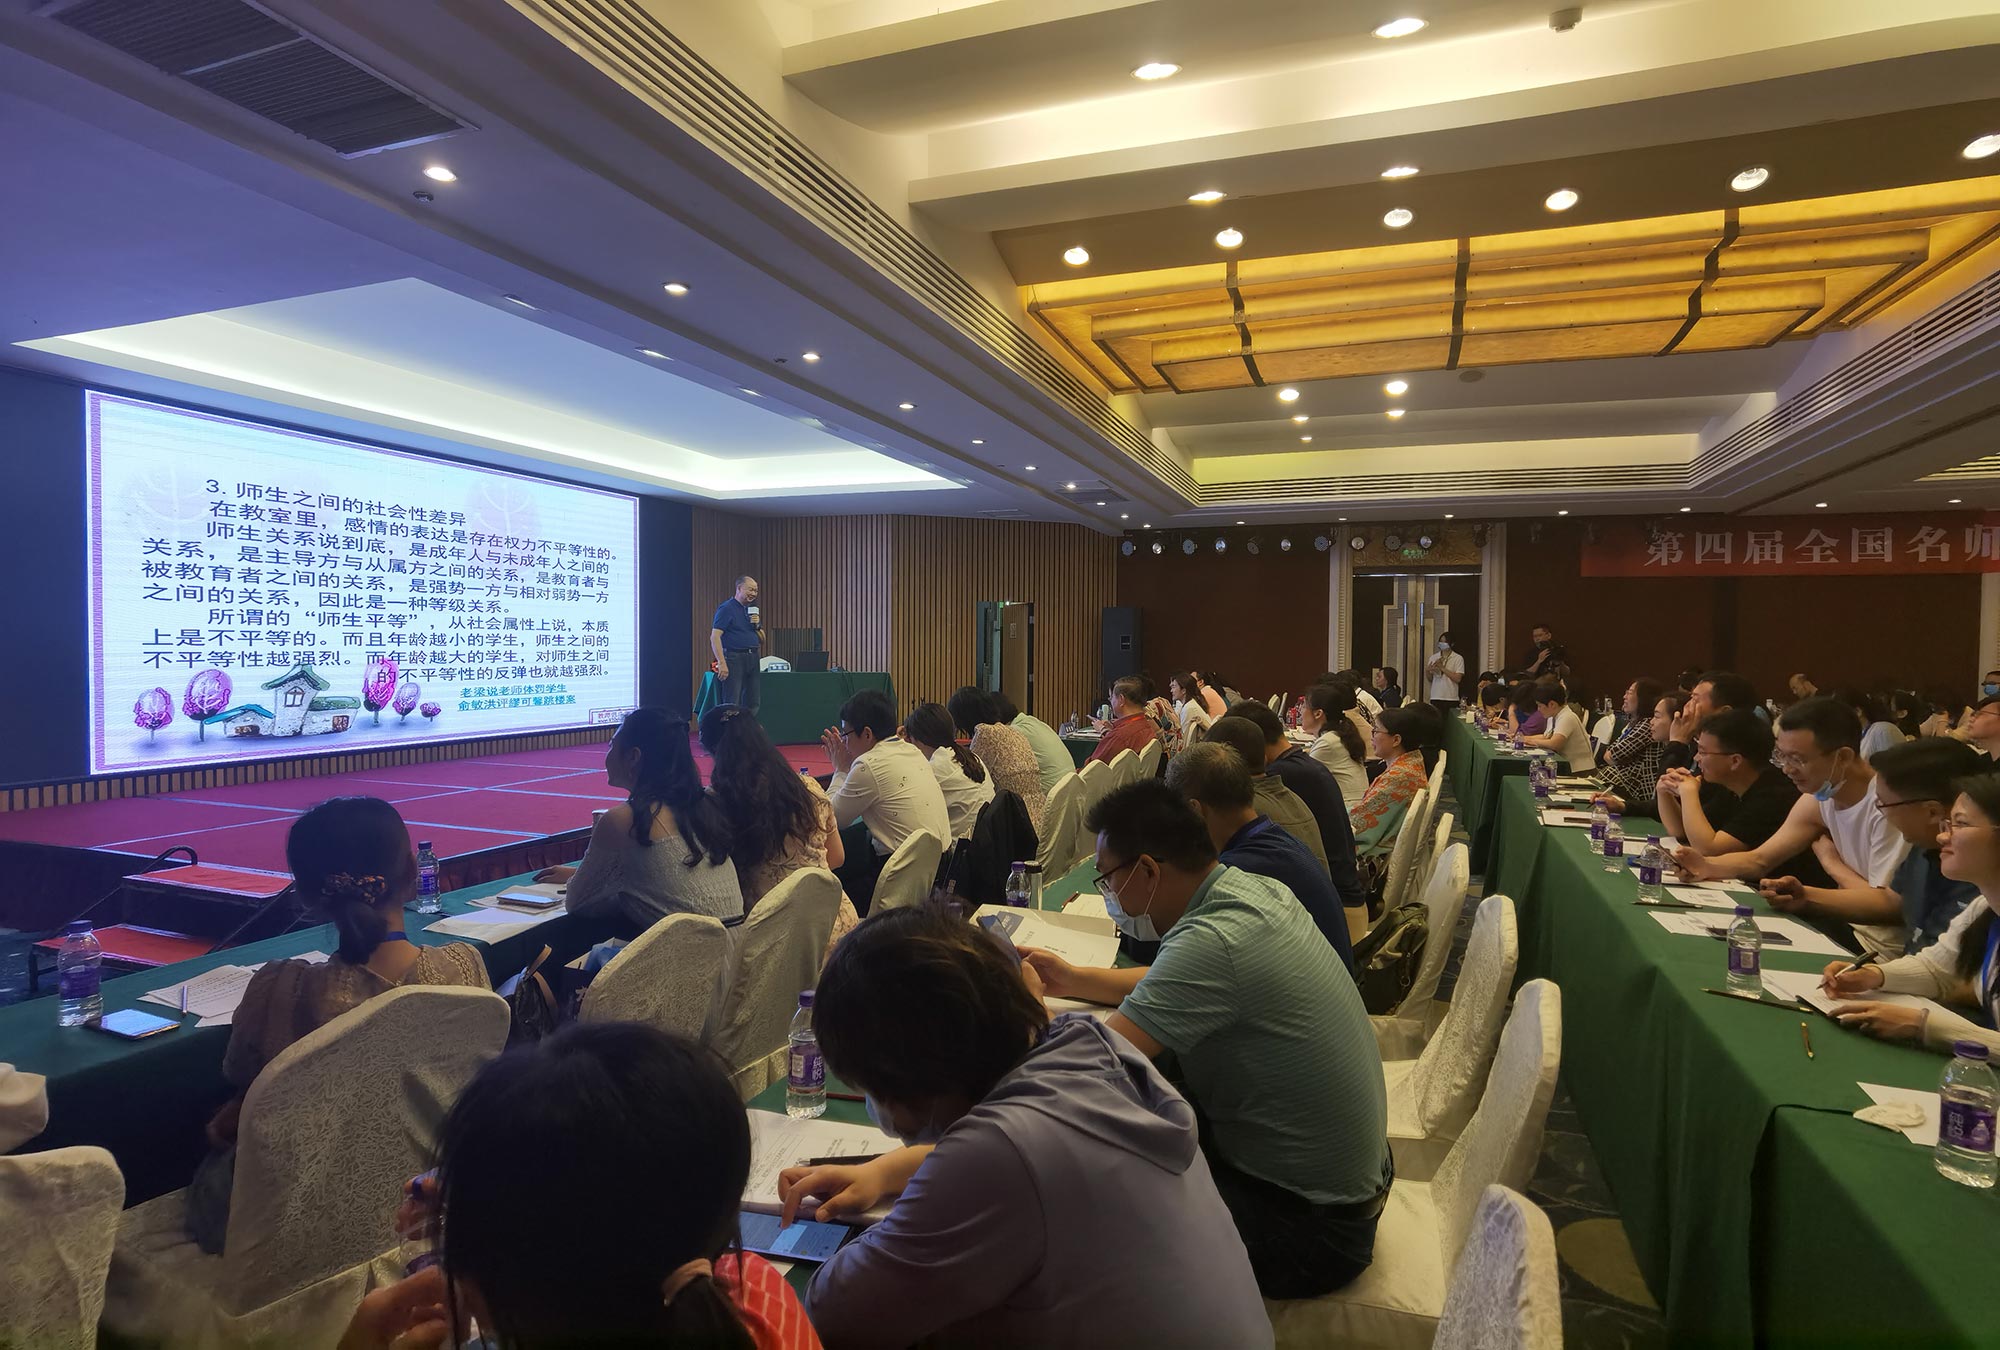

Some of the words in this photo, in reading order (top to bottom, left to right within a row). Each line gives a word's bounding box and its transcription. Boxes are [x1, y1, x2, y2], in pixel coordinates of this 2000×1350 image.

[206, 521, 609, 574] 师生关系说到底，是成年人与未成年人之间的
[209, 500, 618, 560] 在教室里，感情的表达是存在权力不平等性的。
[1644, 525, 2000, 567] 第四届全国名师
[141, 559, 609, 603] 被教育者之间的关系，是强势一方与相对弱势一方
[142, 537, 609, 588] 关系，是主导方与从属方之间的关系，是教育者与
[142, 582, 512, 614] 之间的关系，因此是一种等级关系。
[142, 628, 609, 648] 上是不平等的。而且年龄越小的学生，师生之间的
